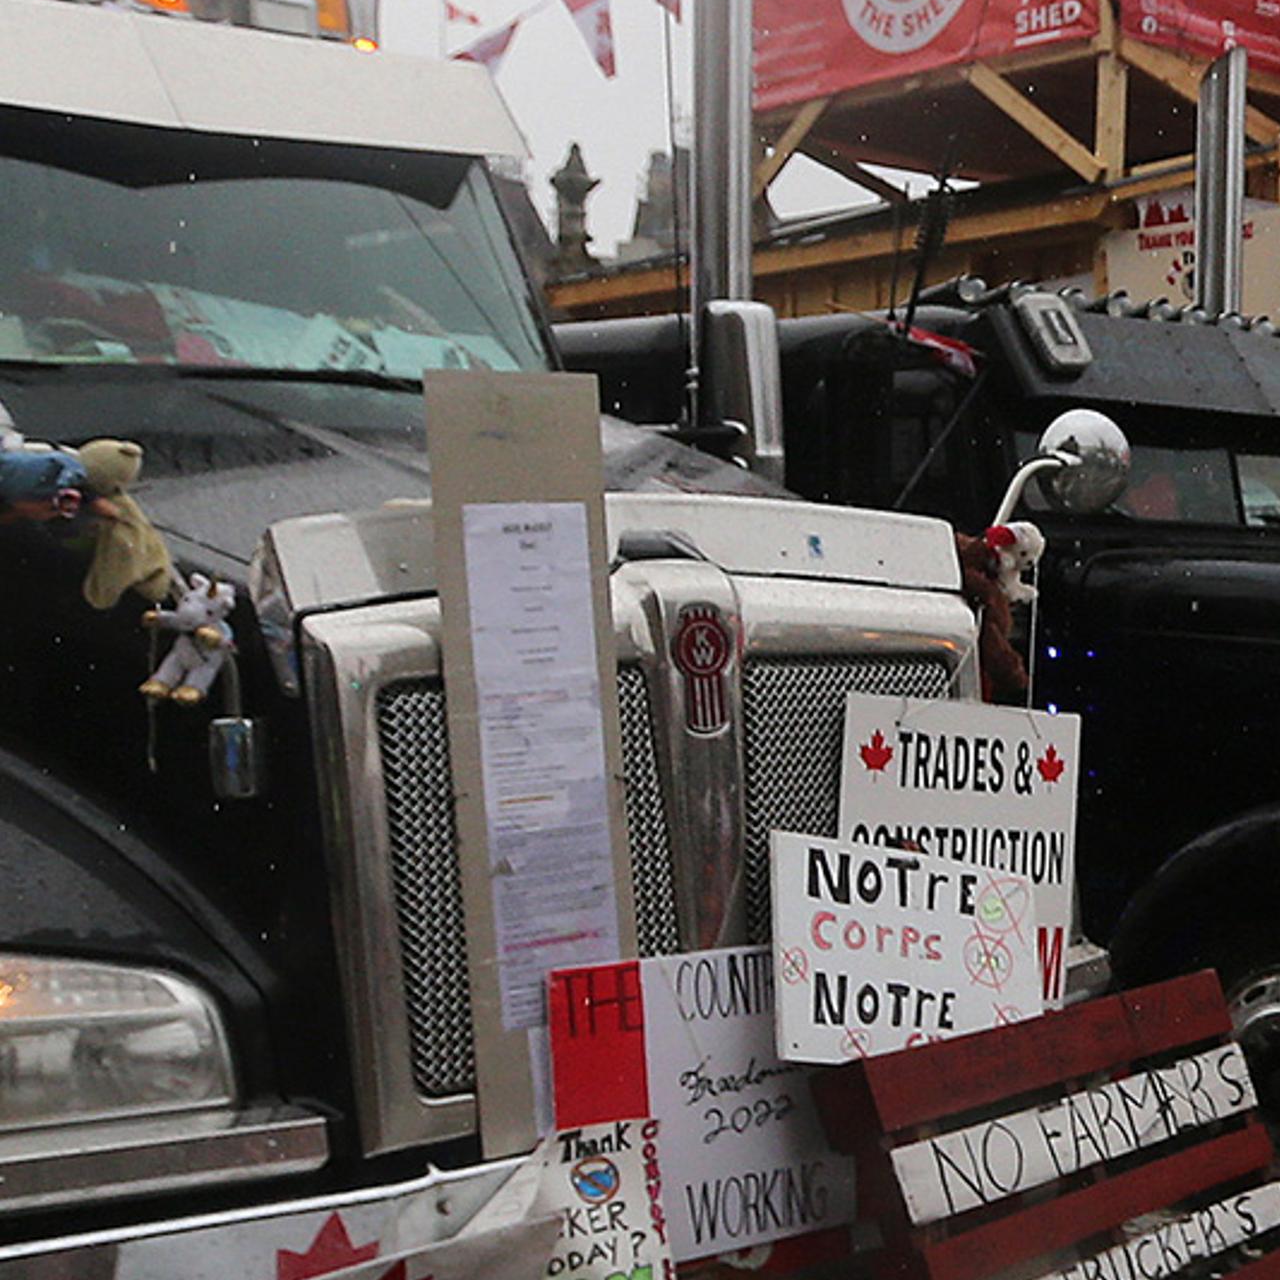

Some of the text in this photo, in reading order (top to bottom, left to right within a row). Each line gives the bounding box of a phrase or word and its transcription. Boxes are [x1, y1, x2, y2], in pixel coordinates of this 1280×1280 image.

[859, 0, 895, 39] THE
[898, 731, 1034, 796] TRADES &
[551, 969, 642, 1038] THE
[558, 1123, 632, 1164] Thank
[704, 1094, 794, 1144] 2022
[931, 1122, 1024, 1215] NO
[558, 1201, 629, 1238] KER
[686, 1161, 828, 1245] WORKING
[546, 1237, 618, 1278] ODAY
